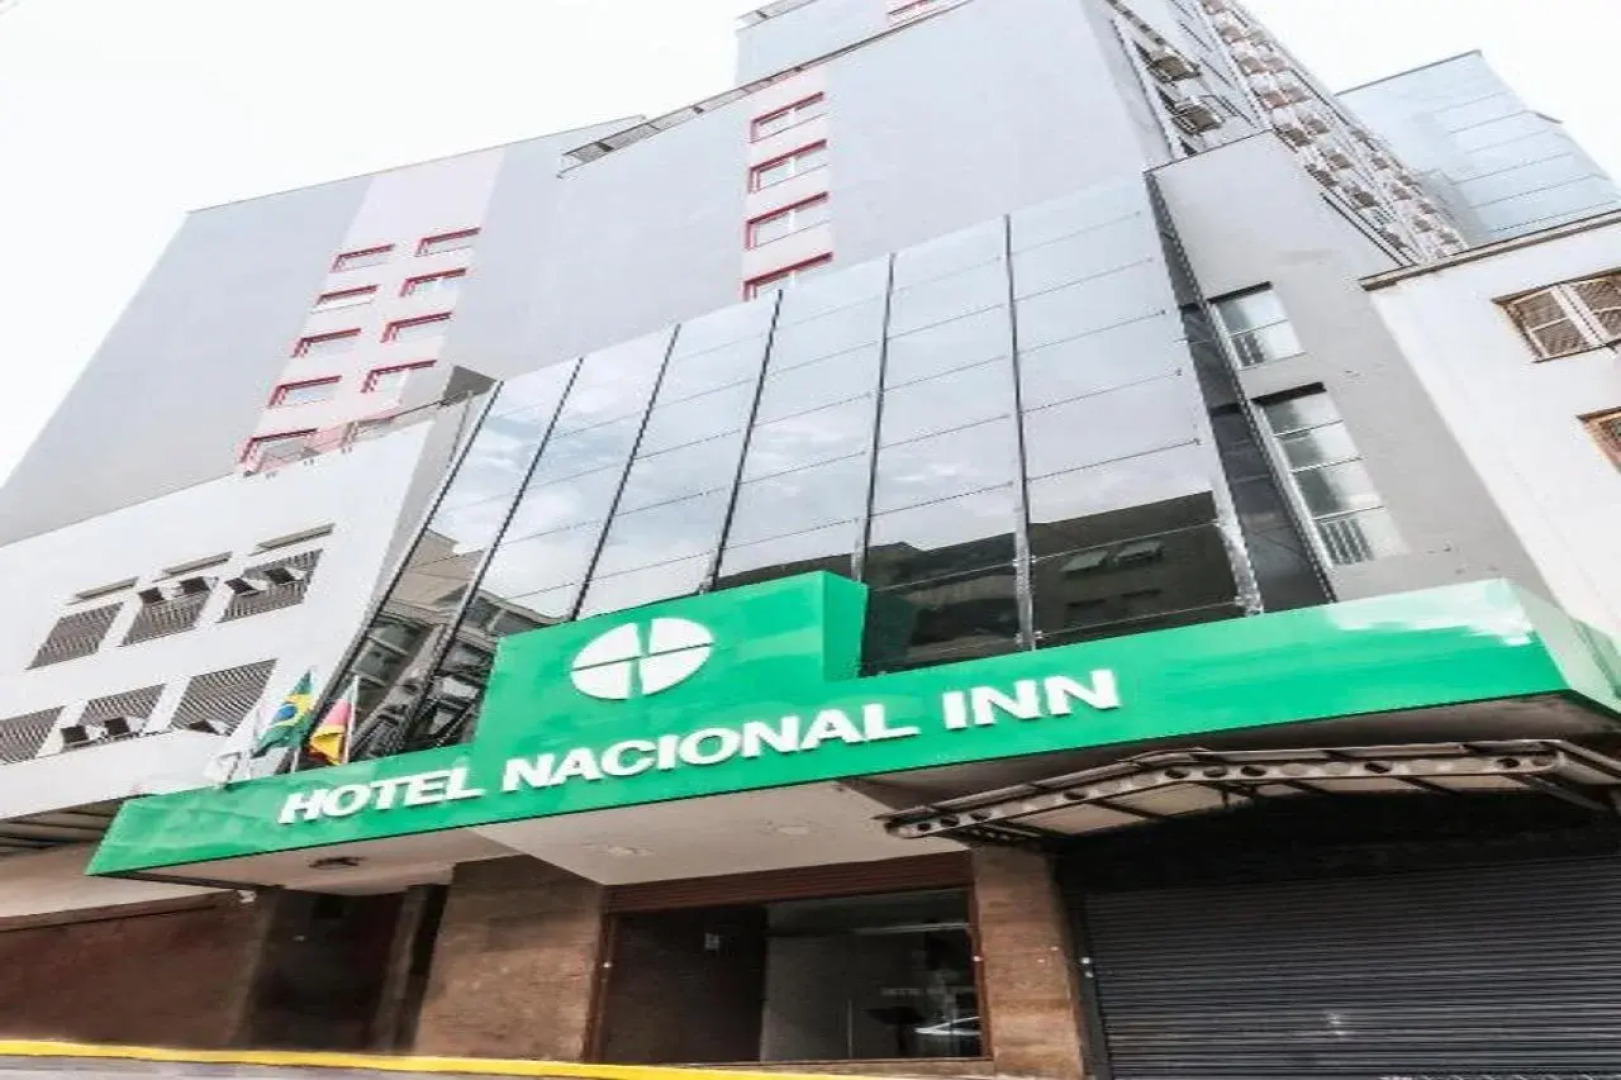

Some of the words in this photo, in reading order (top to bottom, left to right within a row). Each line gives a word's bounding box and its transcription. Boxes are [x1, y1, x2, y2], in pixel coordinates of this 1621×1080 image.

[278, 766, 484, 824] HOTEL
[503, 704, 918, 792] NACIONAL
[942, 669, 1120, 730] INN
